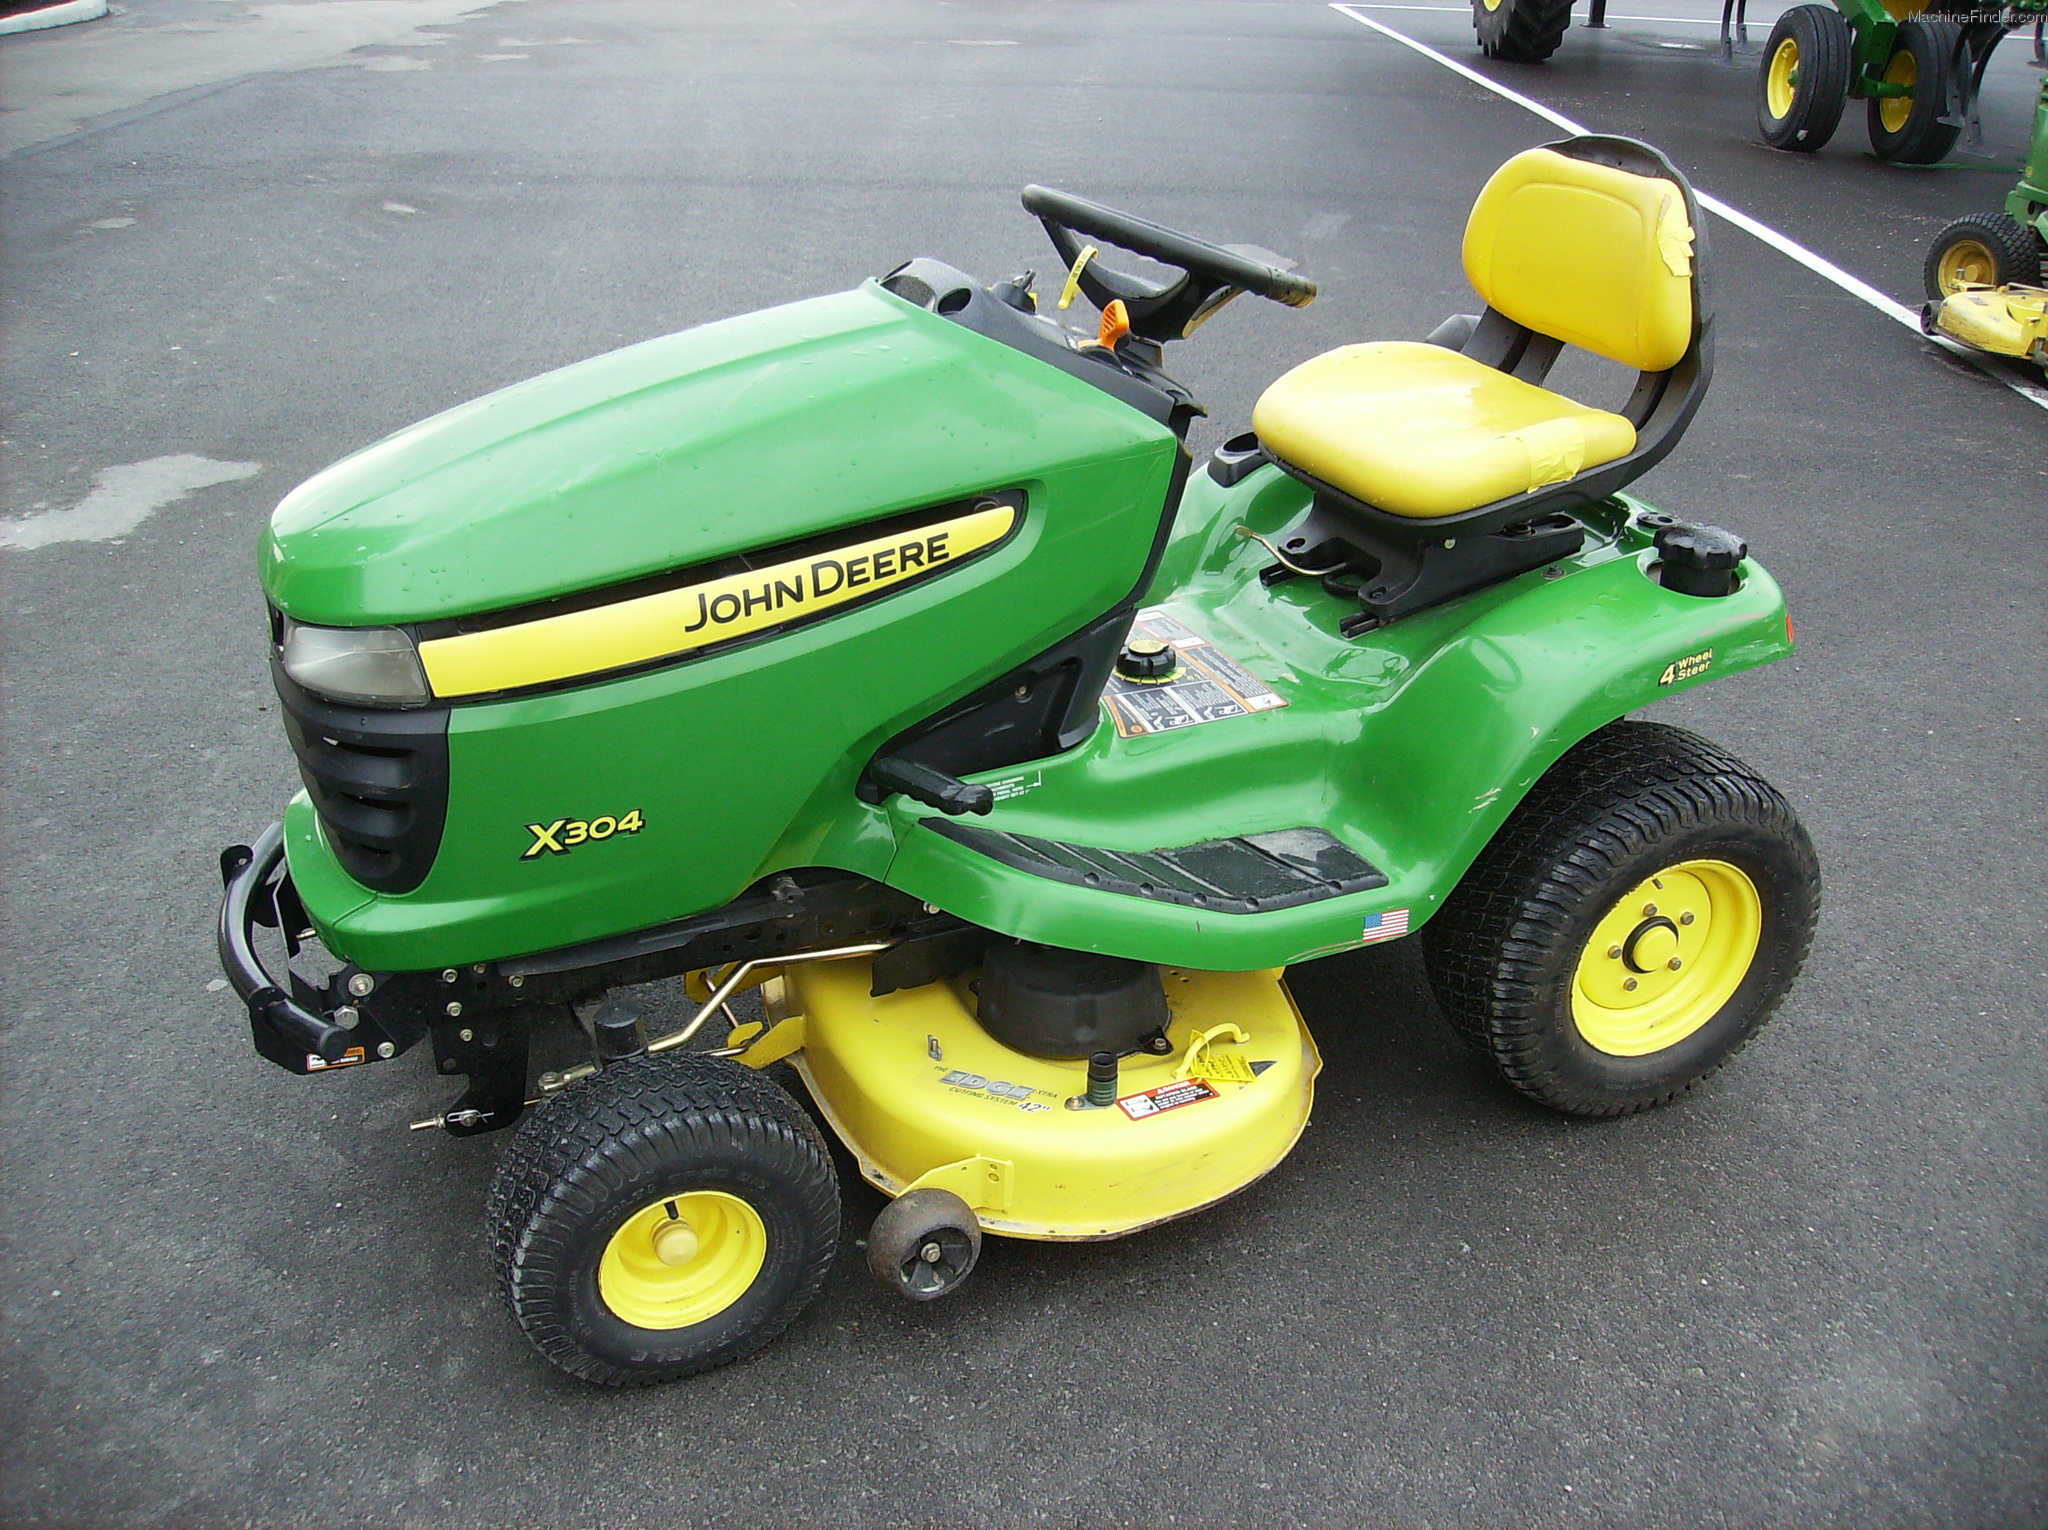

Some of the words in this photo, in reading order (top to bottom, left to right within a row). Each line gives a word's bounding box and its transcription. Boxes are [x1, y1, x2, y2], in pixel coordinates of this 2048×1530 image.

[685, 575, 804, 632] JOHN
[811, 532, 950, 598] DEERE
[1658, 662, 1676, 686] 4
[1678, 647, 1713, 669] Wheel
[1677, 661, 1711, 681] Steer
[520, 808, 645, 861] X304
[939, 1070, 1036, 1101] EDGE
[1036, 1089, 1059, 1099] XTRA
[949, 1086, 985, 1099] CUTTING
[983, 1094, 1018, 1106] SYSTEM
